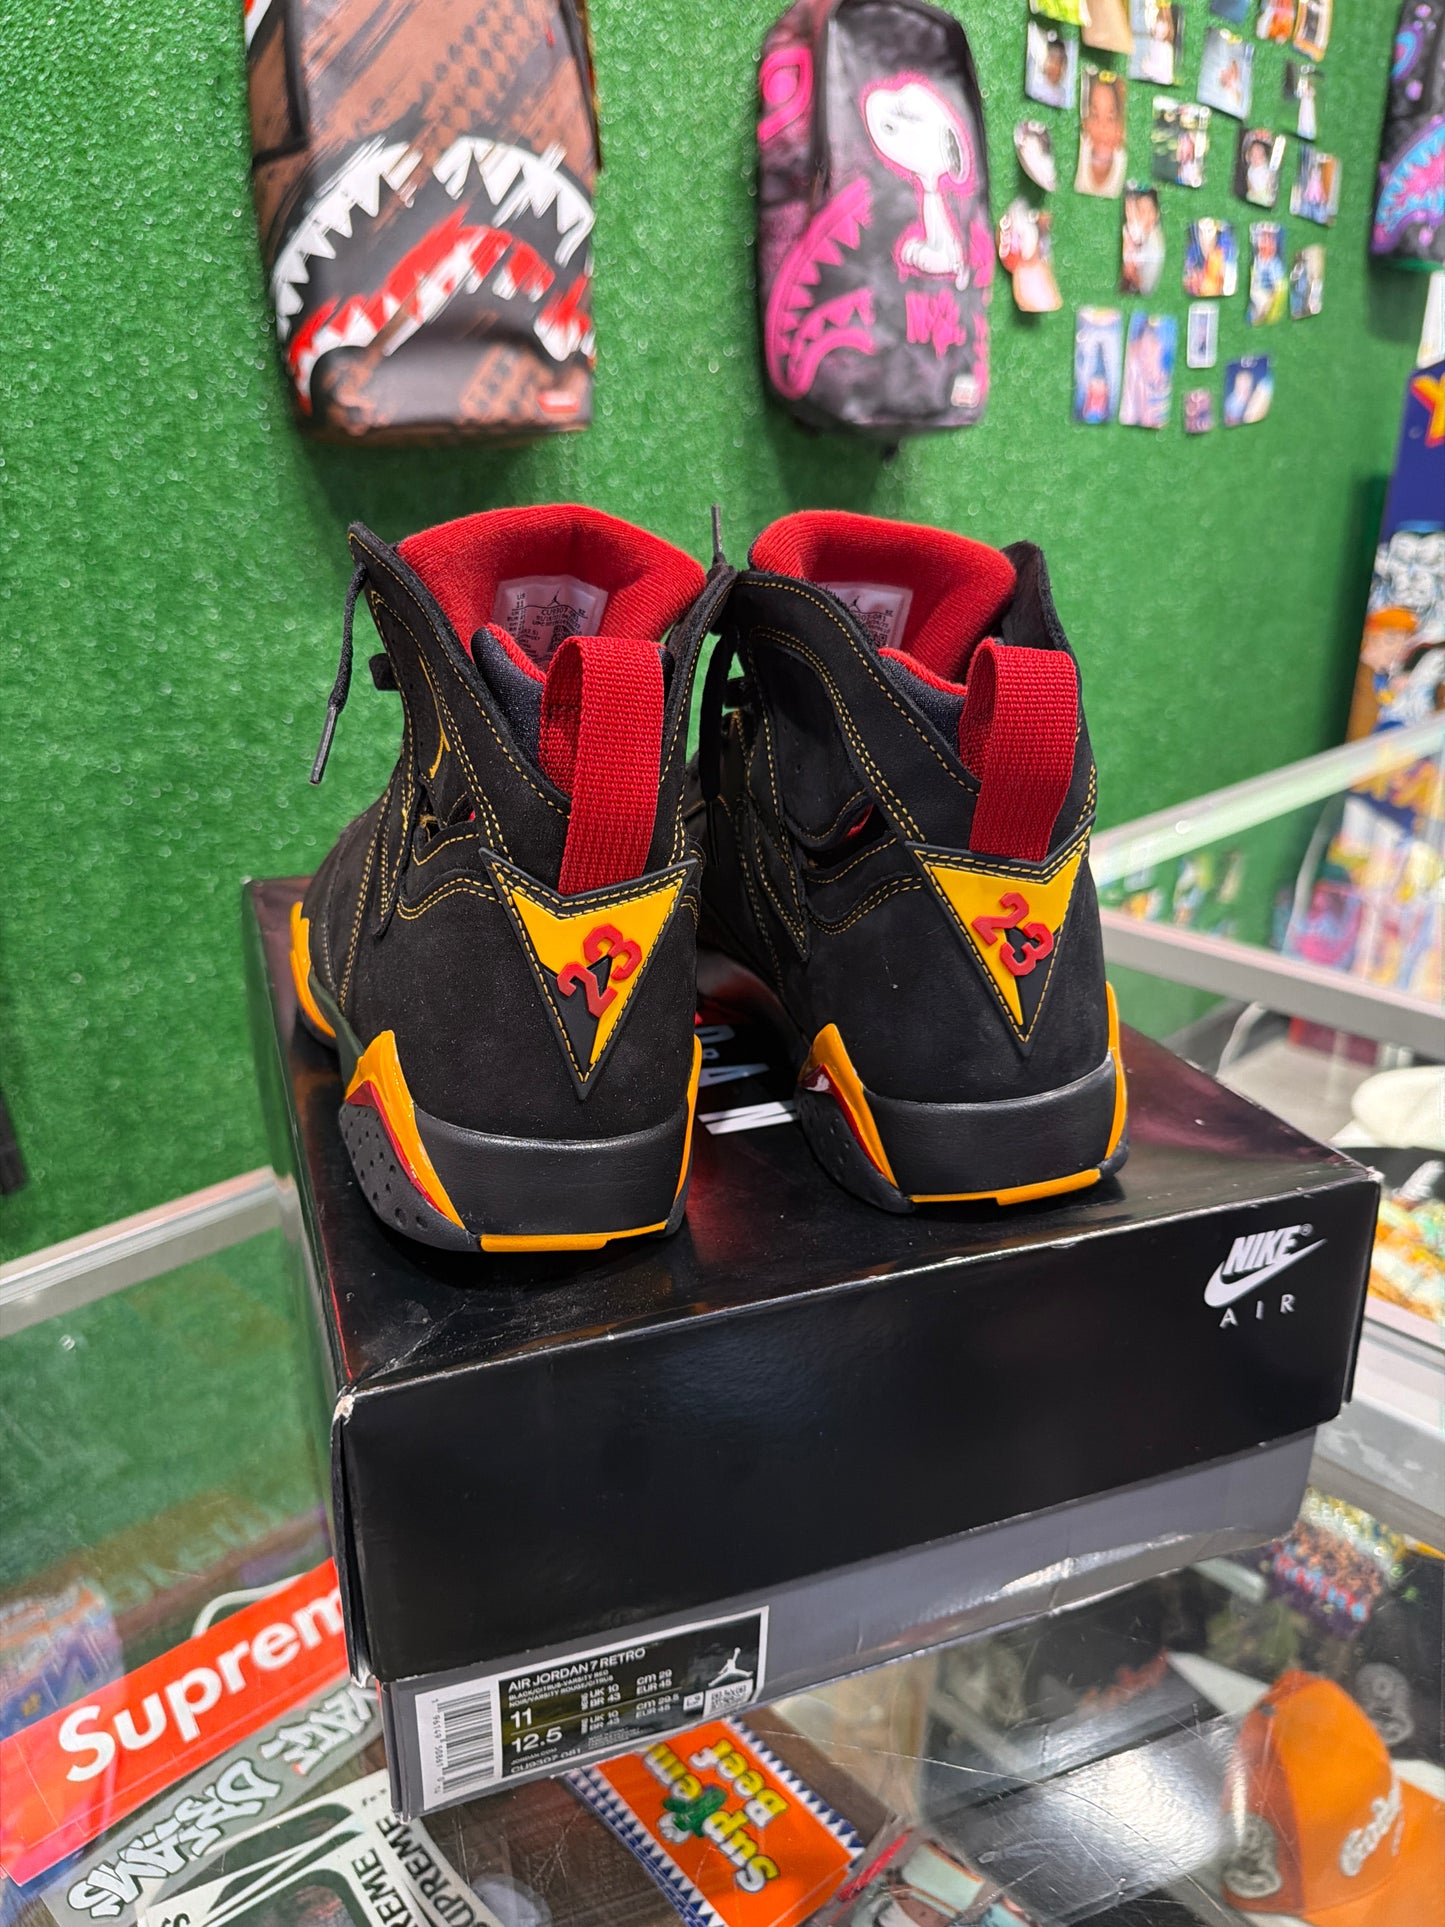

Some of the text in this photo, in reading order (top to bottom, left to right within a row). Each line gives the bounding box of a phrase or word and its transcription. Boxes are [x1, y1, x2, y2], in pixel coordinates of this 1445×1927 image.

[971, 892, 1054, 976] 23
[557, 923, 642, 1018] 23
[1222, 1225, 1302, 1276] NIKE
[1219, 1294, 1296, 1329] AIR
[508, 1647, 646, 1693] AIR JORDAN 7 RETRO
[593, 1669, 609, 1680] RED
[659, 1669, 672, 1680] 29
[589, 1683, 620, 1698] UK 10
[589, 1697, 605, 1708] BR
[608, 1692, 621, 1702] 43
[636, 1679, 672, 1696] EUR 45
[510, 1707, 532, 1729] 11
[589, 1709, 619, 1724] UK 10
[636, 1707, 656, 1719] EUR
[511, 1726, 563, 1753] 12.5
[689, 1739, 789, 1829] Beef
[67, 1757, 283, 1918] DREAMS
[376, 1816, 490, 1927] UPREME
